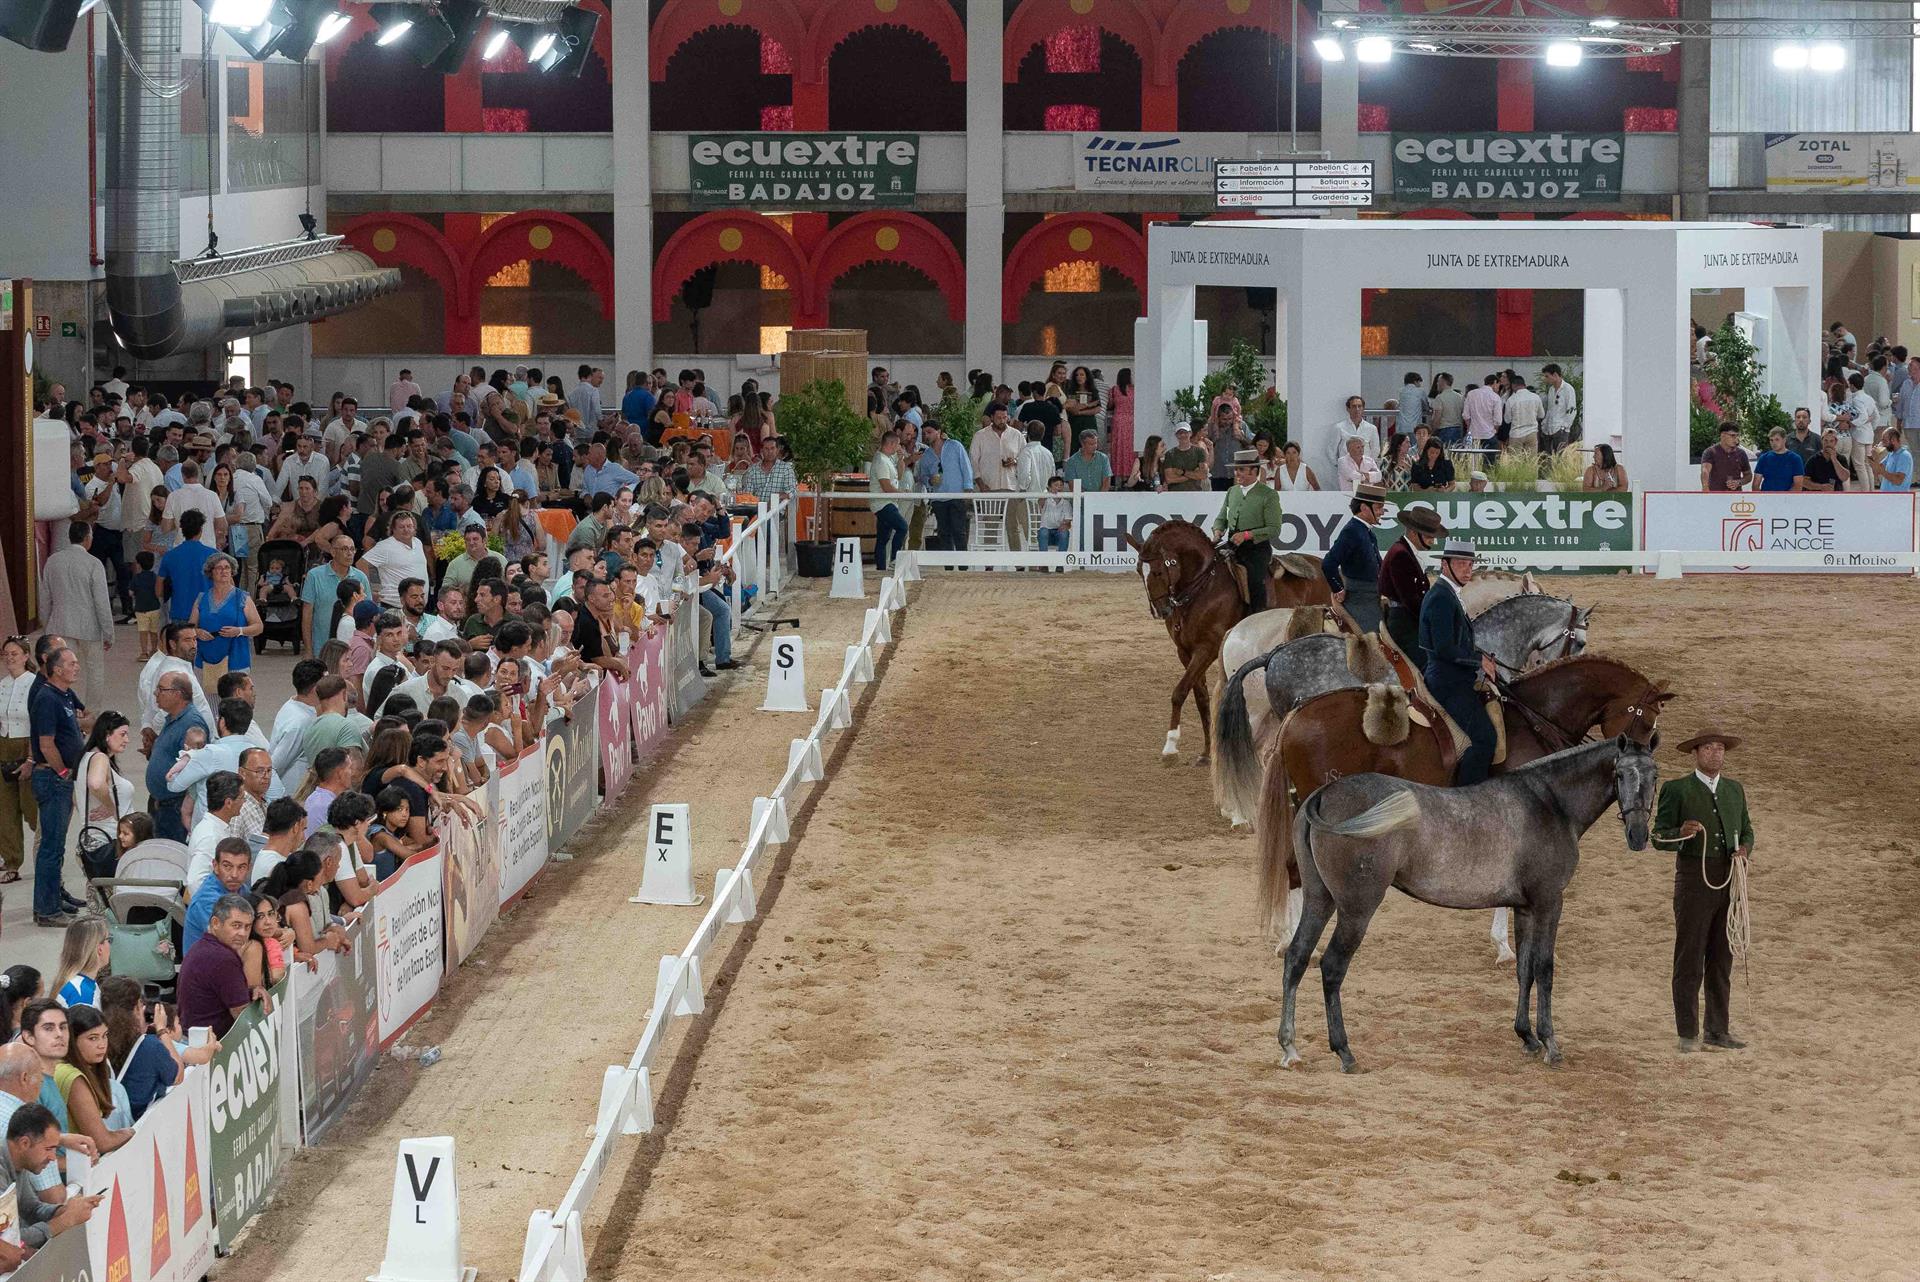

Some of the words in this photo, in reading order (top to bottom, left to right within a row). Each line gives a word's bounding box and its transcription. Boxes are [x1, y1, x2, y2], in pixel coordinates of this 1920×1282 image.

[692, 136, 915, 166] ecuextre
[1394, 134, 1621, 163] ecuextre
[1798, 140, 1851, 151] ZOTAL
[729, 170, 754, 179] FERIA
[760, 170, 775, 179] DEL
[781, 170, 820, 179] CABALLO
[826, 170, 830, 178] Y
[837, 170, 847, 178] EL
[852, 170, 875, 178] TORO
[1432, 168, 1457, 177] FERIA
[1463, 168, 1478, 177] DEL
[1484, 168, 1524, 177] CABALLO
[1530, 168, 1535, 177] Y
[1541, 168, 1551, 177] EL
[1556, 168, 1579, 177] TORO
[1239, 178, 1284, 186] Información
[1431, 181, 1580, 199] BADAJOZ
[728, 183, 875, 200] BADAJOZ
[1170, 251, 1195, 265] JUNTA
[1198, 252, 1208, 264] DE
[1210, 251, 1270, 266] EXTREMADURA
[1427, 254, 1463, 268] JUNTA
[1466, 254, 1480, 267] DE
[1484, 254, 1569, 267] EXTREMADURA
[1703, 253, 1728, 269] JUNTA
[1730, 253, 1739, 266] DE
[1742, 252, 1799, 266] EXTREMADURA
[1771, 518, 1835, 535] PRE
[1470, 536, 1515, 545] CABALLO
[1523, 536, 1529, 545] Y
[1536, 536, 1546, 545] EL
[1554, 536, 1579, 545] TORO
[1771, 537, 1835, 550] ANCCE
[840, 543, 854, 563] H
[842, 566, 849, 575] G
[776, 643, 794, 668] S
[636, 701, 656, 745] Pavo
[655, 812, 674, 845] E
[658, 848, 667, 862] X
[418, 921, 428, 944] de
[403, 1153, 441, 1202] V
[415, 1205, 427, 1224] L
